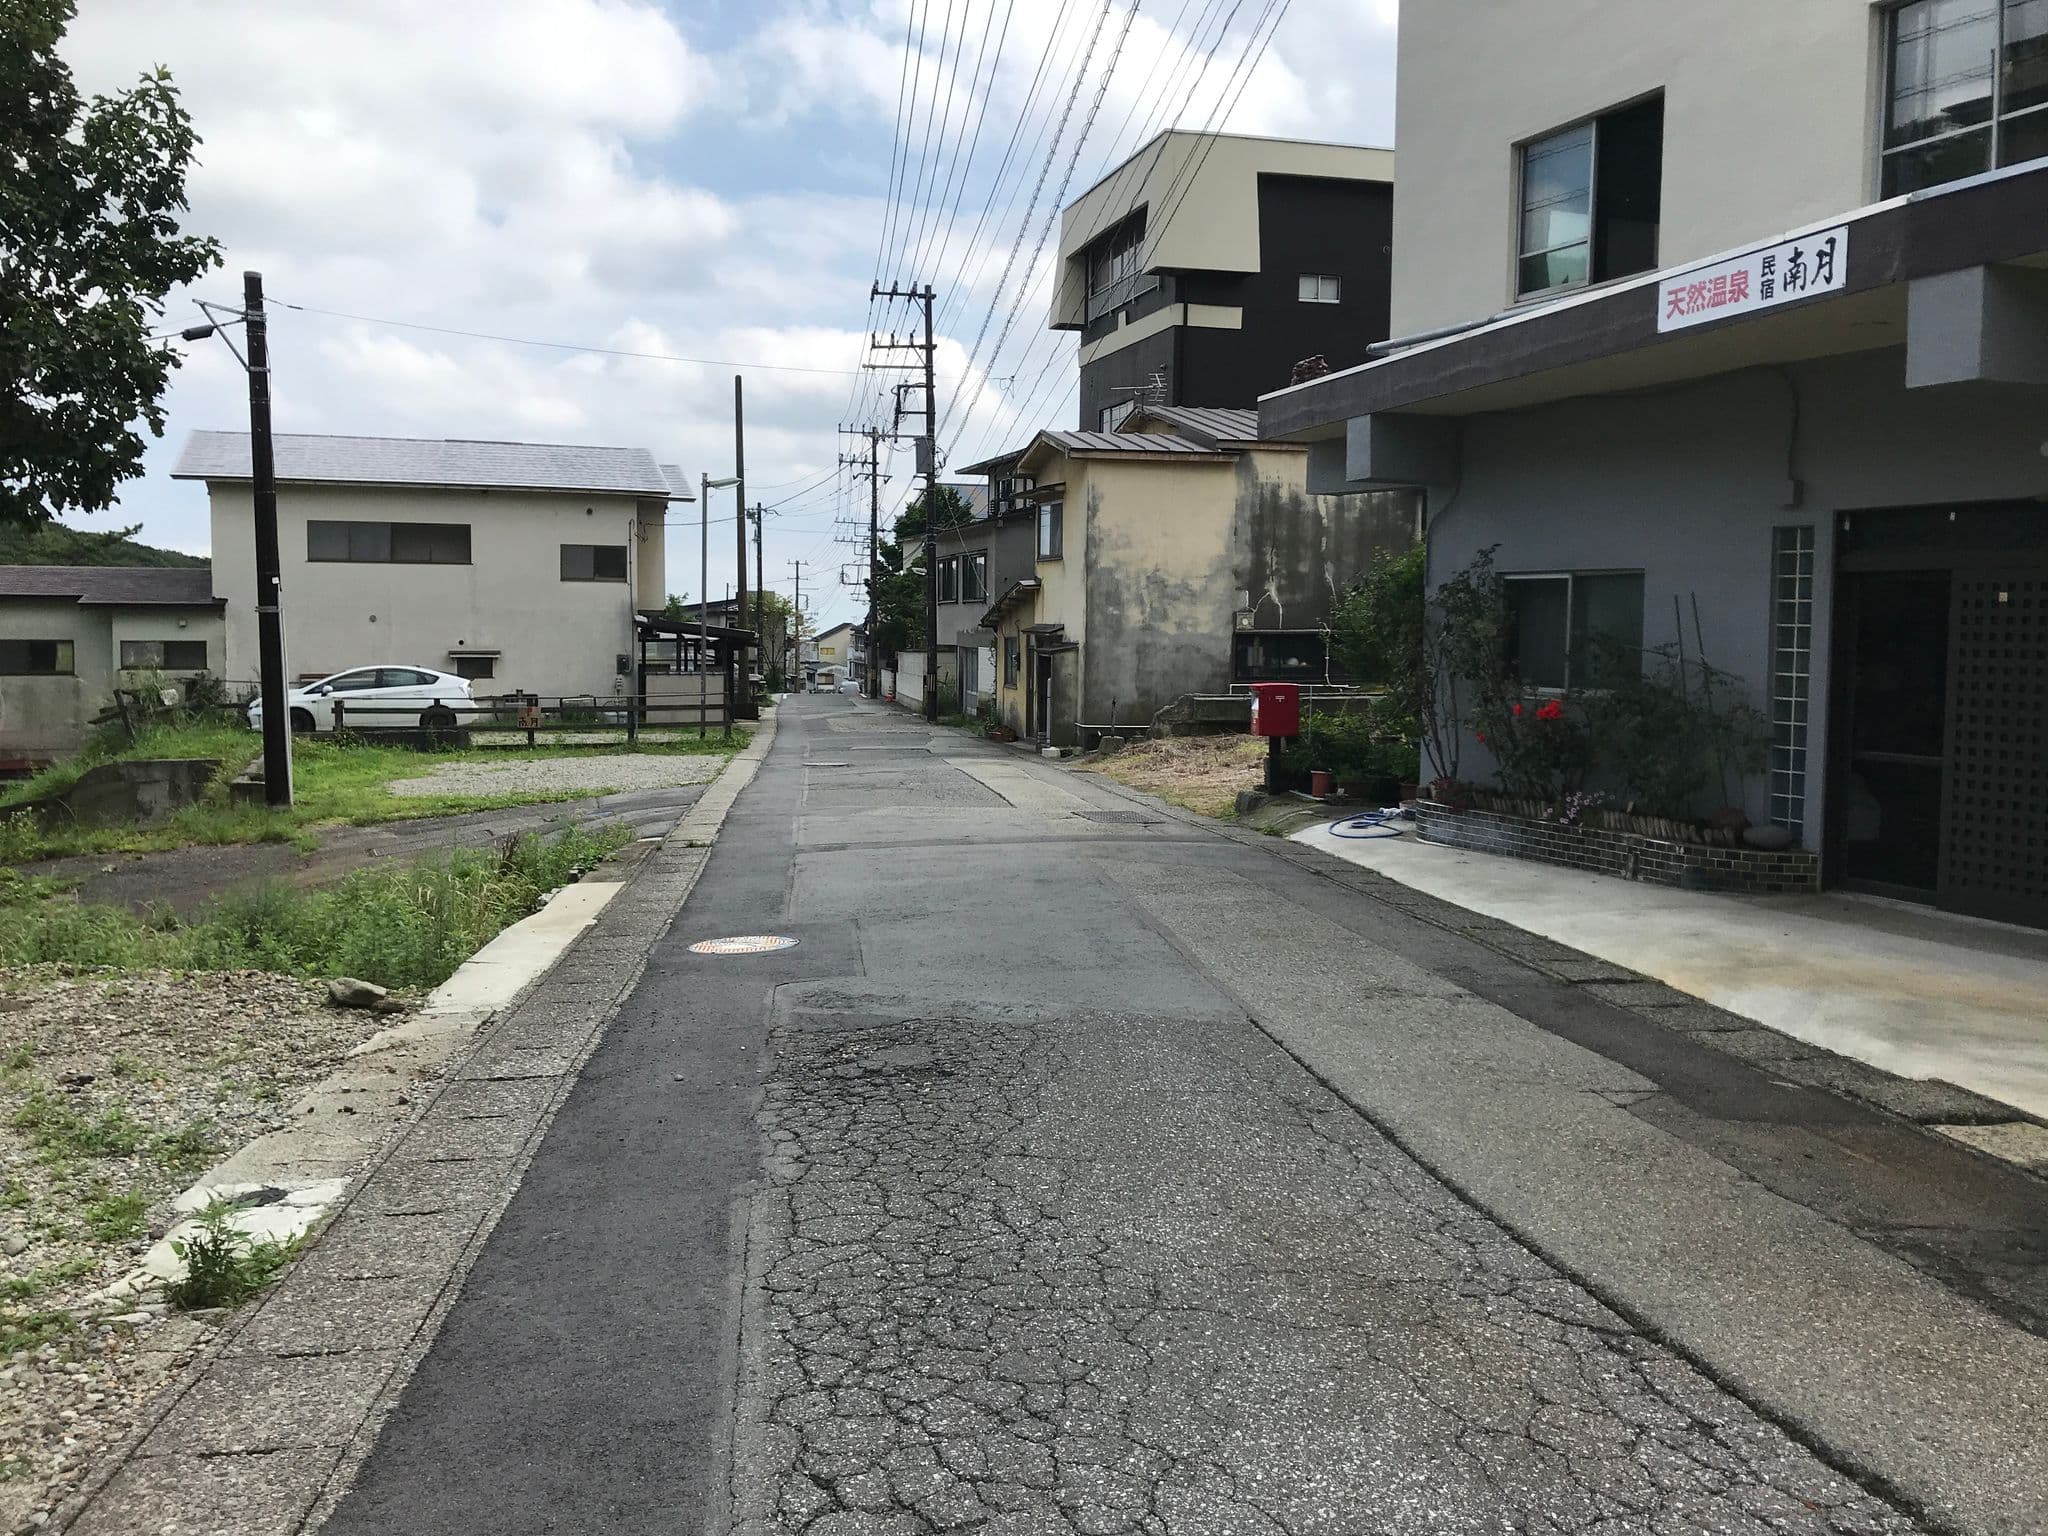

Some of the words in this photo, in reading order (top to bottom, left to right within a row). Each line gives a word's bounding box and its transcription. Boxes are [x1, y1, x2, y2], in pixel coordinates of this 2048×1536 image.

[1666, 269, 1749, 320] 天然温泉
[1760, 254, 1776, 301] 民宿
[1783, 236, 1837, 292] 南月
